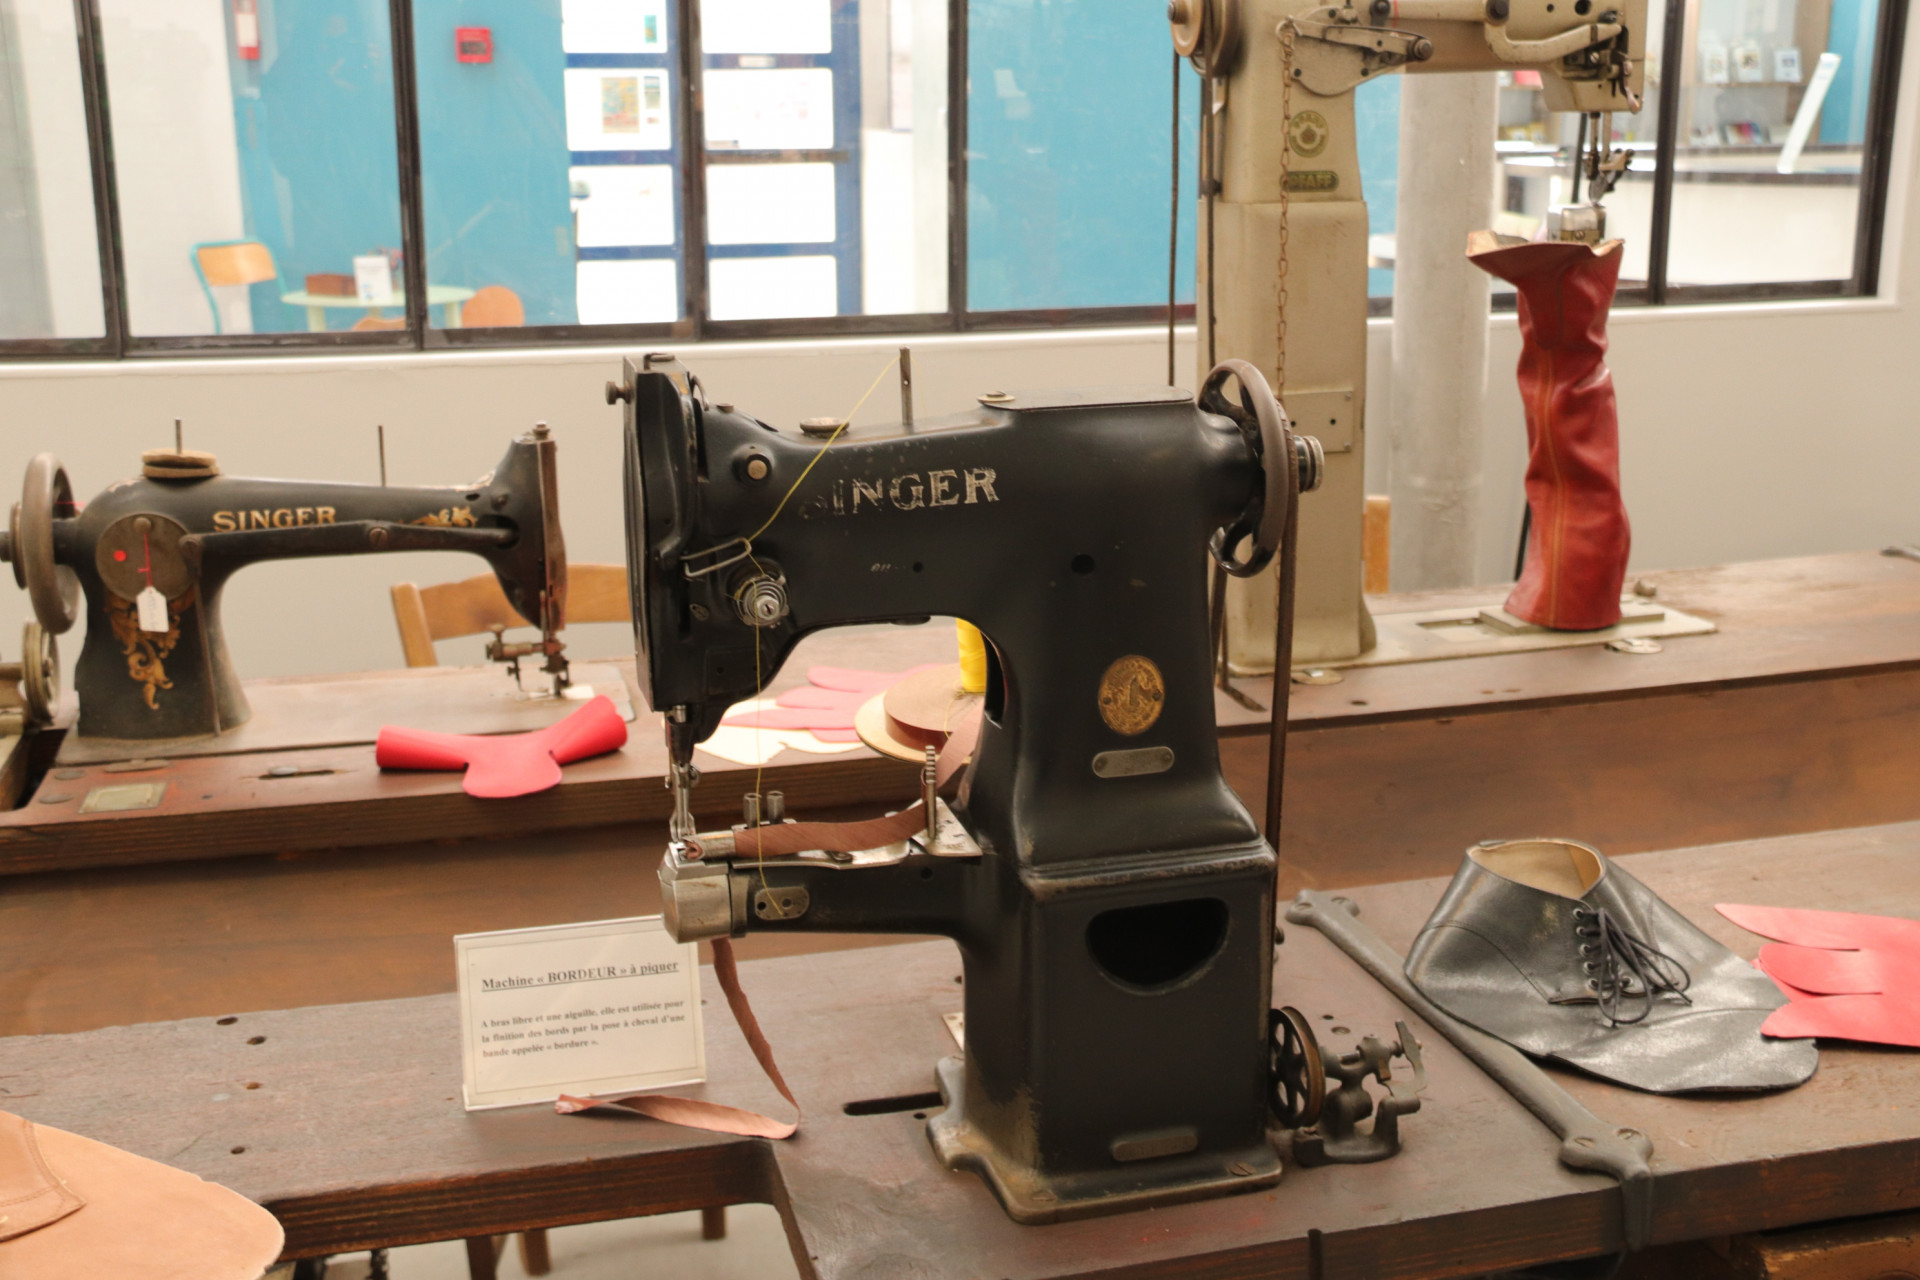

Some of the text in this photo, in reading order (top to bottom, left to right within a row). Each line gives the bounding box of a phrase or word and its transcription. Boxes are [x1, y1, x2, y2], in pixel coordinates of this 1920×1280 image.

[800, 467, 1000, 518] INGER
[212, 506, 337, 532] SINGER
[482, 976, 534, 990] Machine
[547, 966, 617, 983] BORDEUR
[630, 964, 637, 975] à
[640, 962, 679, 976] piquer
[490, 1019, 510, 1028] bras
[512, 1016, 533, 1026] libre
[535, 1015, 544, 1023] et
[600, 1007, 616, 1016] elle
[618, 1006, 630, 1014] est
[632, 1002, 662, 1013] utilisée
[664, 1000, 684, 1010] pour
[481, 1015, 685, 1043] la finition des bords par la pose à cheval d'une
[483, 1048, 509, 1058] bande
[511, 1044, 544, 1056] appelée
[553, 1039, 589, 1050] bordure
